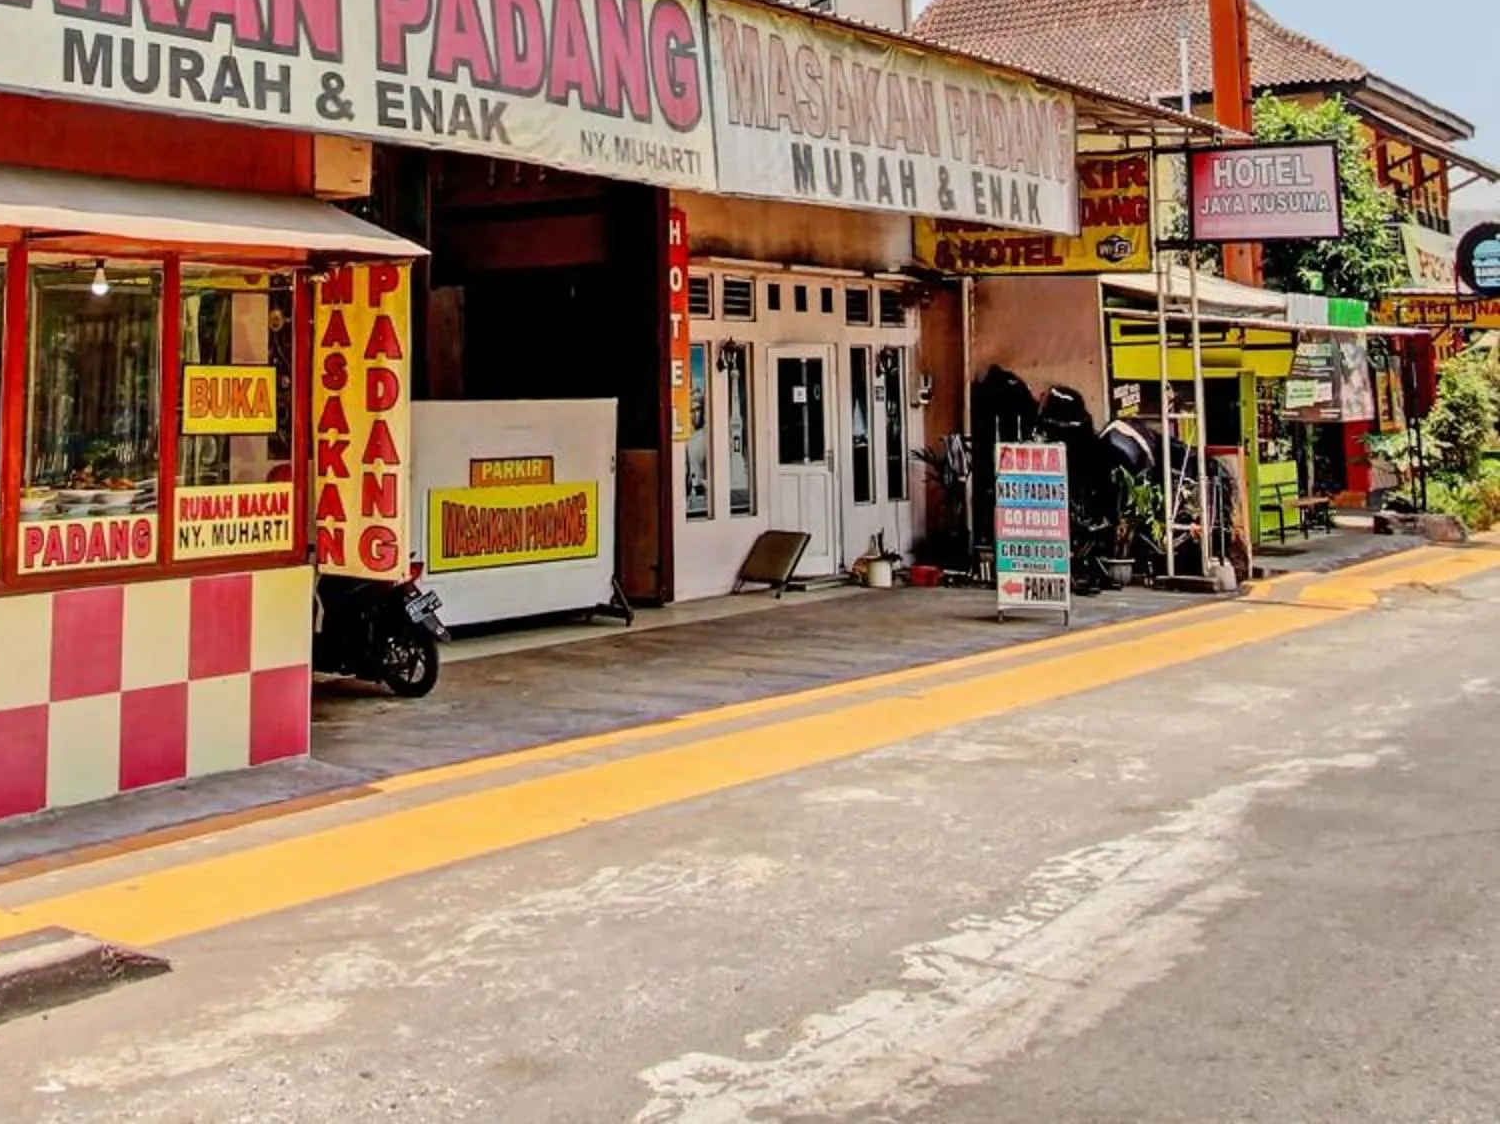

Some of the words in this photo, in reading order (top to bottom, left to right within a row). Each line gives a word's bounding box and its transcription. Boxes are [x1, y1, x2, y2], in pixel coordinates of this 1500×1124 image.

[63, 28, 291, 113] MURAH
[315, 70, 356, 121] &
[377, 81, 511, 145] ENAK
[719, 14, 941, 157] MASAKAN
[944, 84, 1074, 184] PADANG
[614, 136, 701, 174] MUHARTI
[1212, 154, 1313, 189] HOTEL
[791, 141, 917, 208] MURAH
[938, 165, 956, 212] &
[971, 171, 1042, 225] ENAK
[1200, 194, 1246, 216] JAYA
[1250, 191, 1331, 214] KUSUMA
[959, 235, 1064, 267] HOTEL
[668, 219, 684, 434] HOTEL
[188, 376, 273, 419] BUKA
[315, 265, 355, 567] MASAKAN
[357, 262, 403, 573] PADANG
[481, 459, 543, 481] PARKIR
[179, 494, 234, 522] RUMAH
[238, 490, 290, 518] MAKAN
[1024, 482, 1065, 502] PADANG
[23, 517, 153, 569] PADANG
[178, 526, 205, 549] NY.
[211, 519, 289, 547] MUHARTI
[442, 500, 523, 558] MASAKAN
[526, 491, 588, 552] PADANG
[1024, 576, 1067, 602] PARKIR
